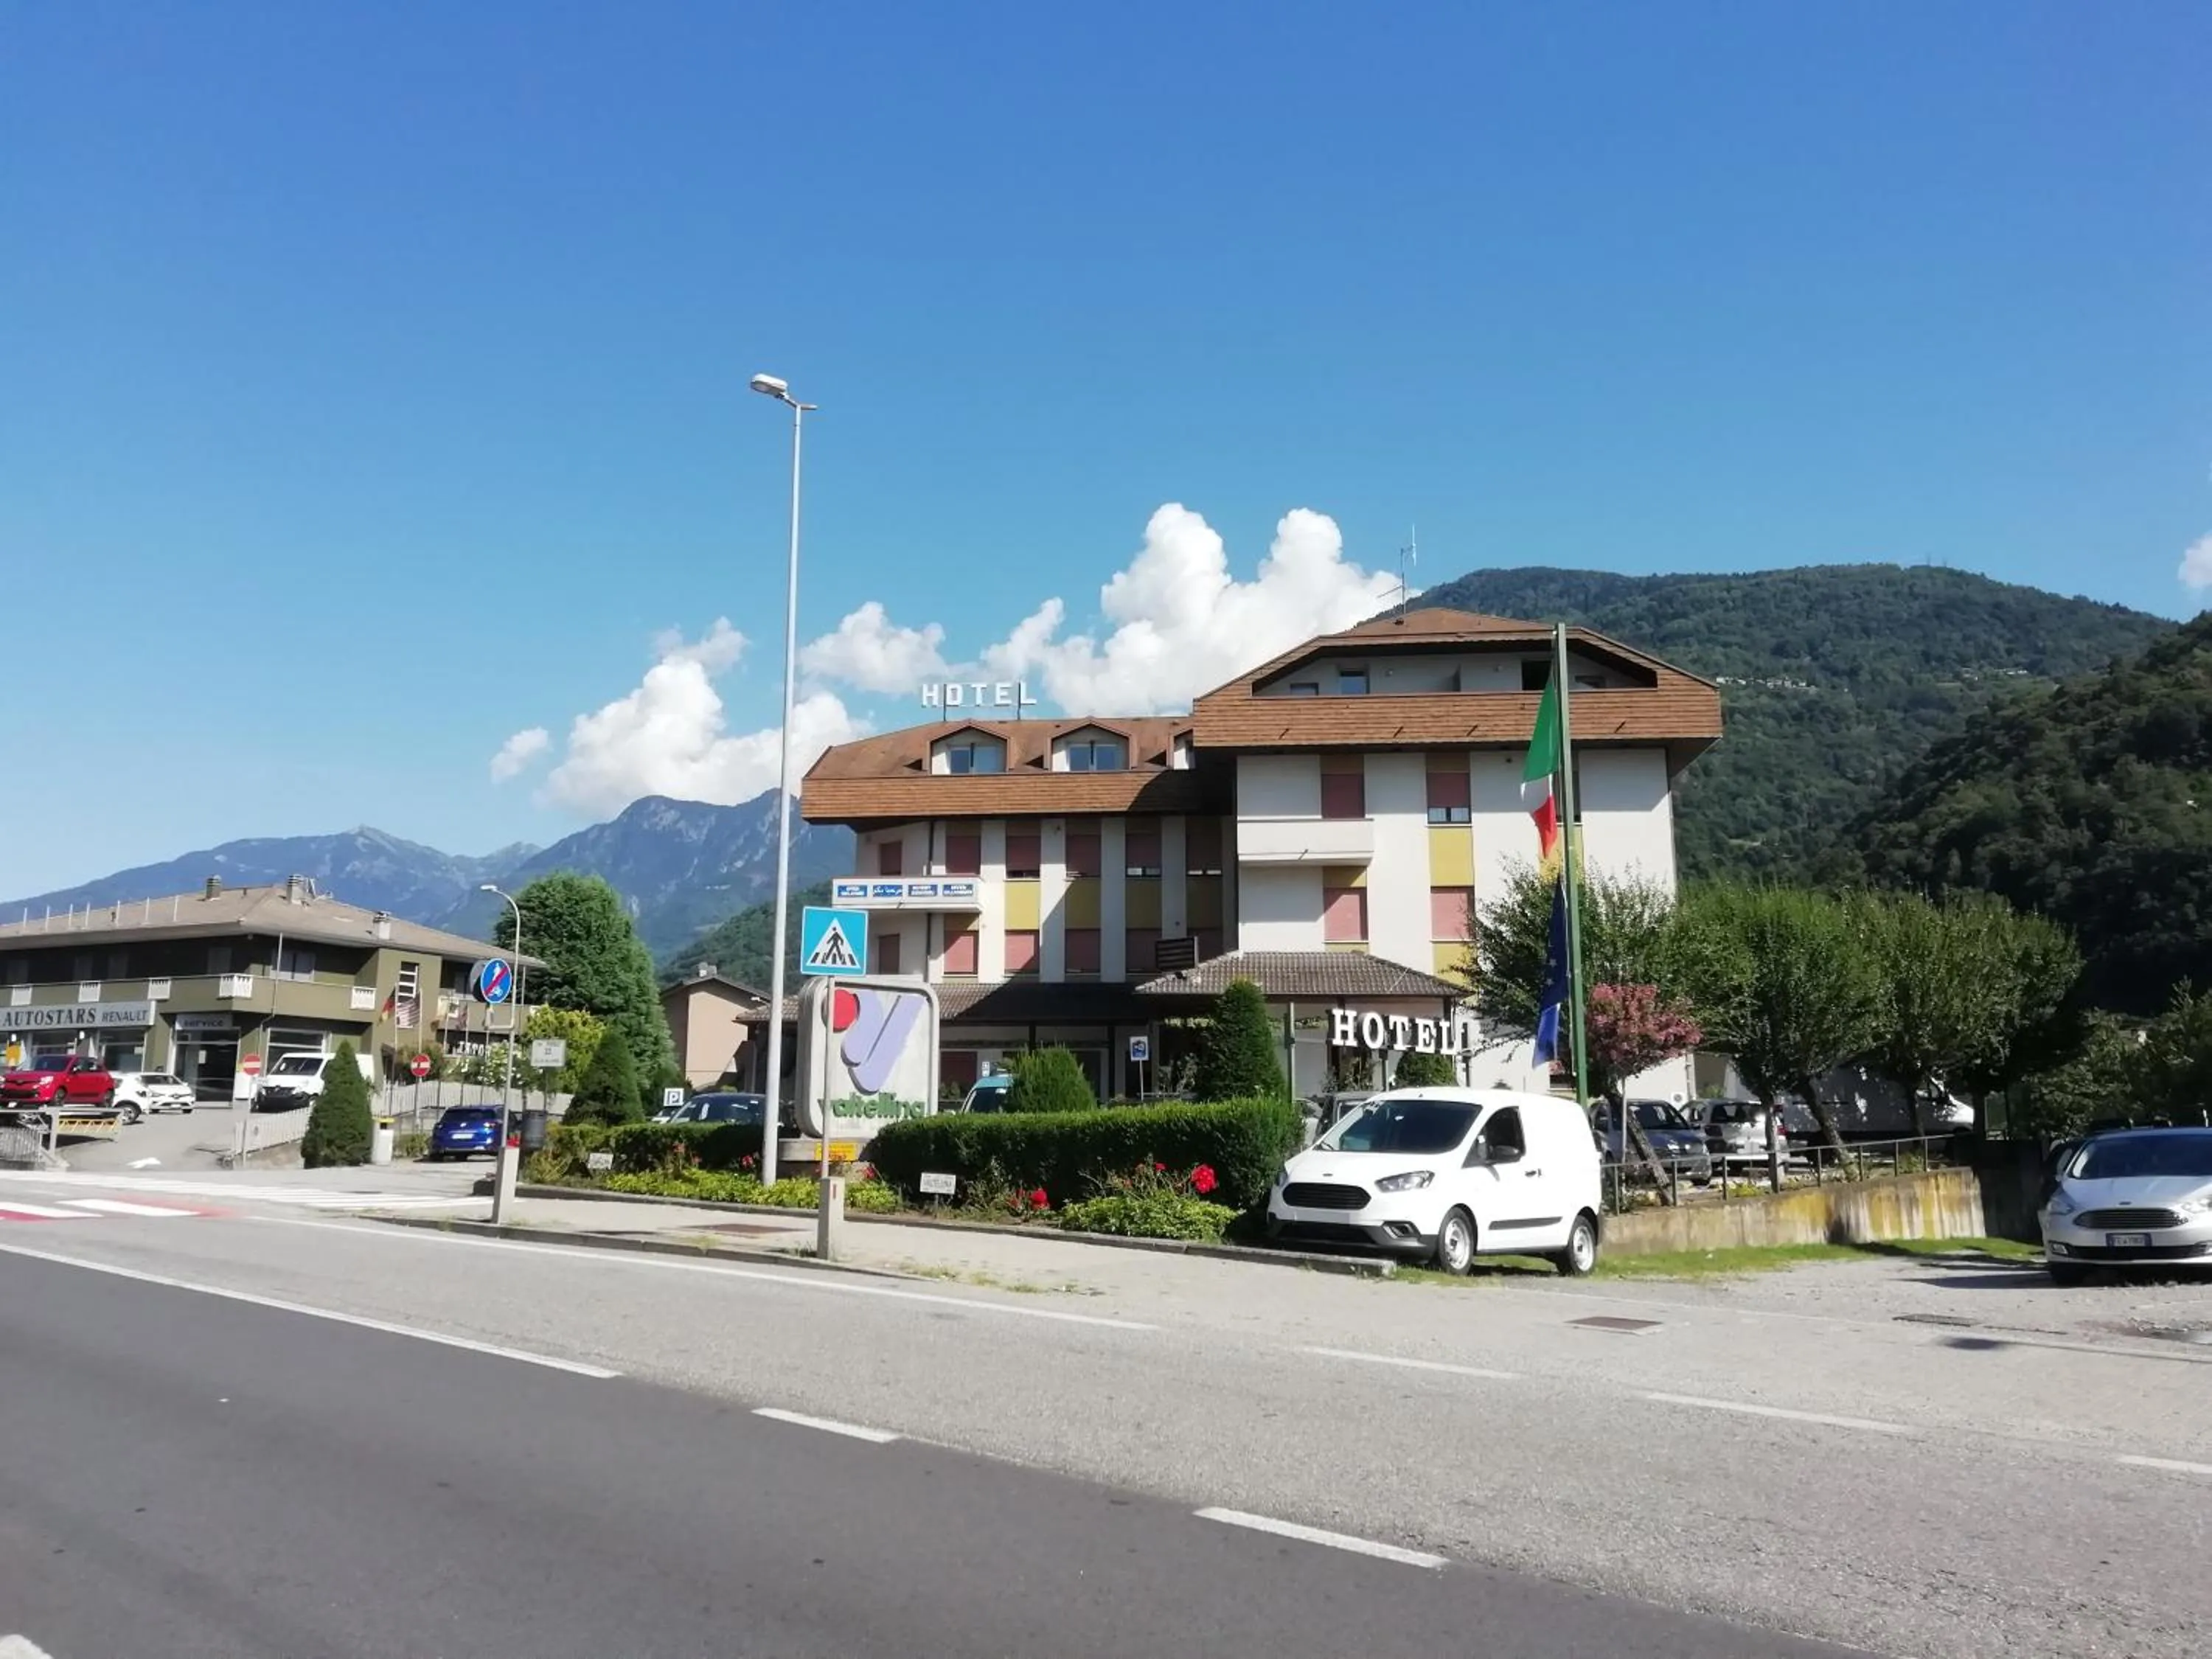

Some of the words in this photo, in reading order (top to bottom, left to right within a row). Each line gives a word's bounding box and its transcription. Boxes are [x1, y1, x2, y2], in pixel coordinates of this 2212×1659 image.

[922, 681, 1037, 706] HOTEL
[3, 1006, 96, 1027] AUTOSTARS
[102, 1009, 148, 1023] RENAULT
[1331, 1008, 1457, 1055] HOTEL
[668, 1092, 679, 1105] P
